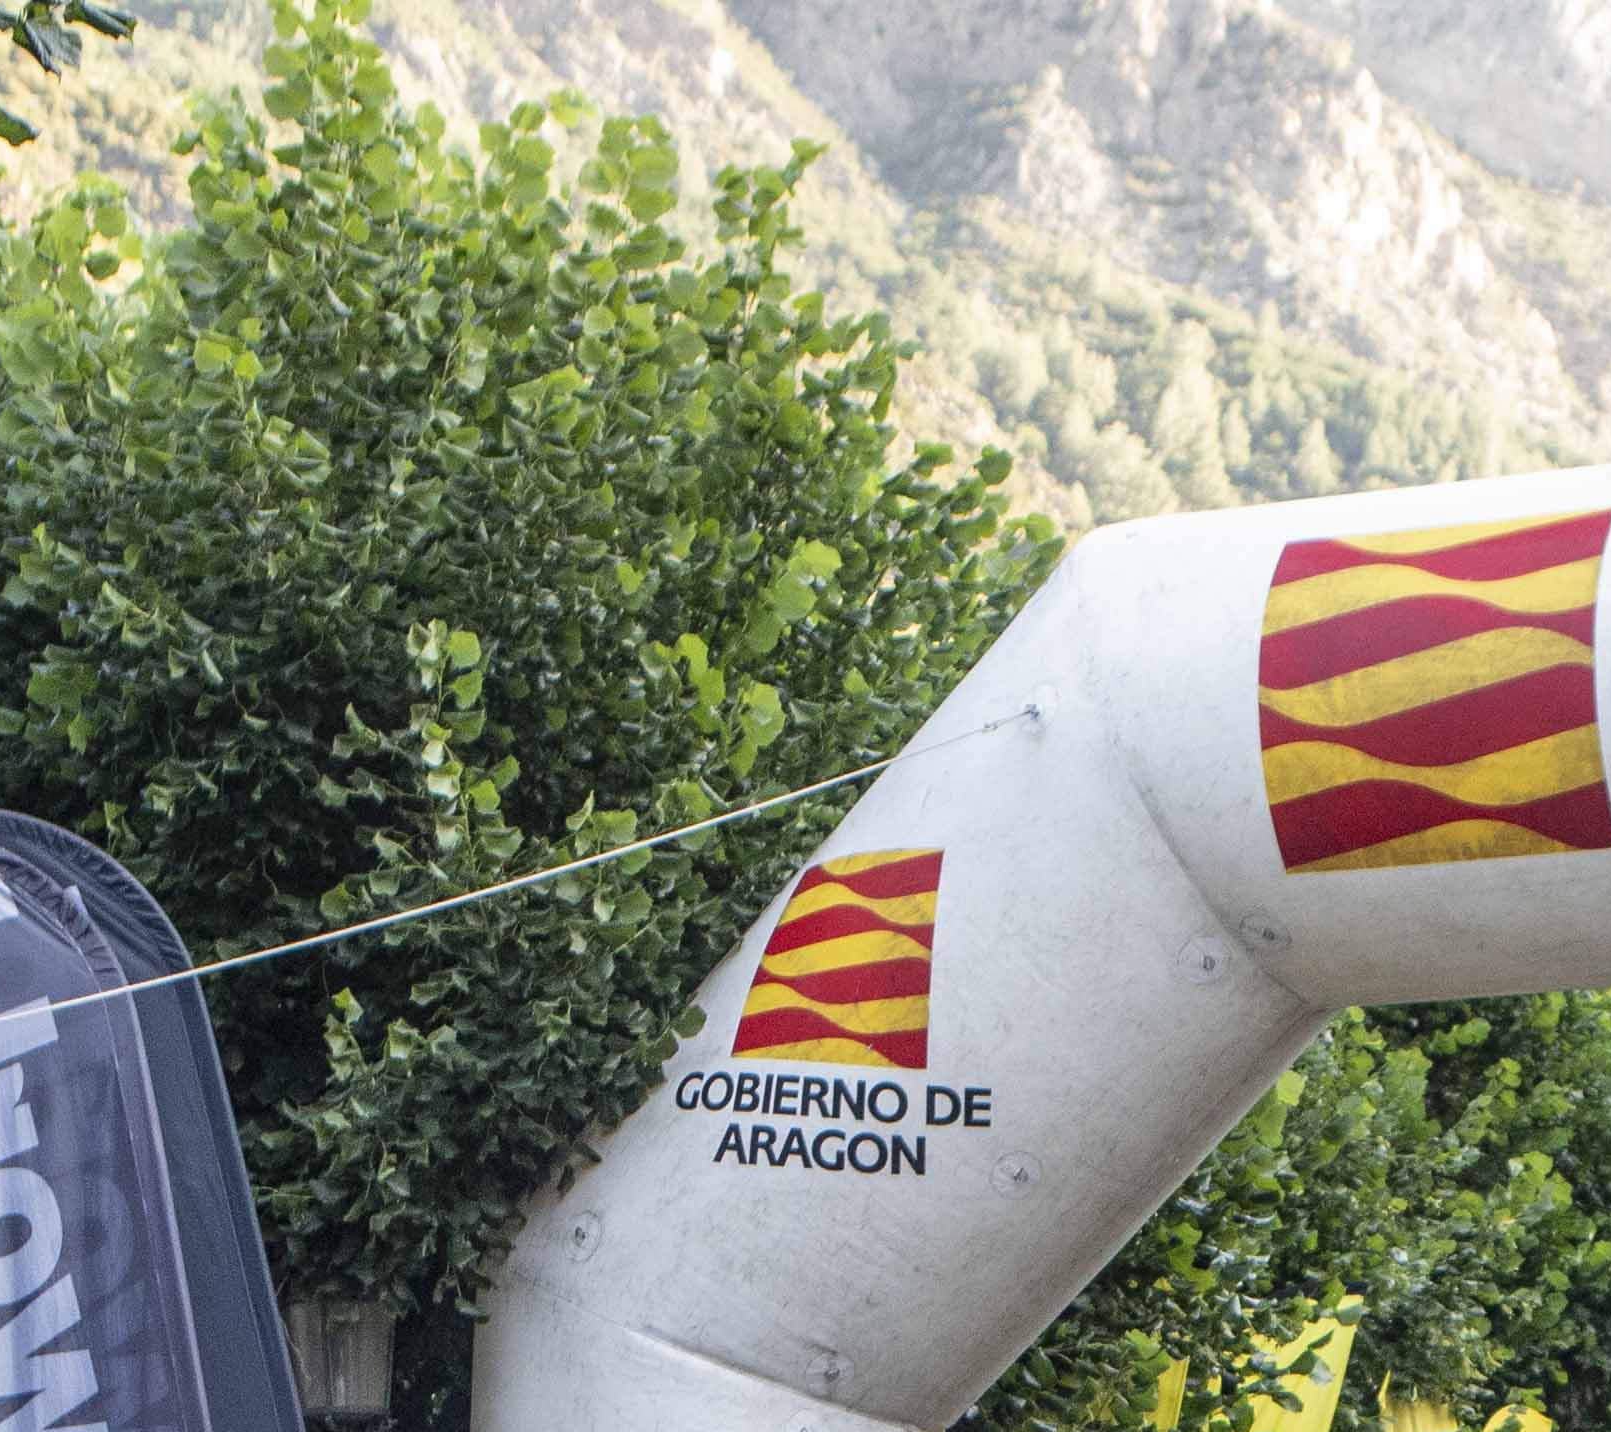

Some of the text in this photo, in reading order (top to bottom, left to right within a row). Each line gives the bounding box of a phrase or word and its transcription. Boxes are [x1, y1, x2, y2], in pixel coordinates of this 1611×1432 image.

[675, 1070, 992, 1129] GOBIERNO DE
[713, 1125, 928, 1177] ARAGON
